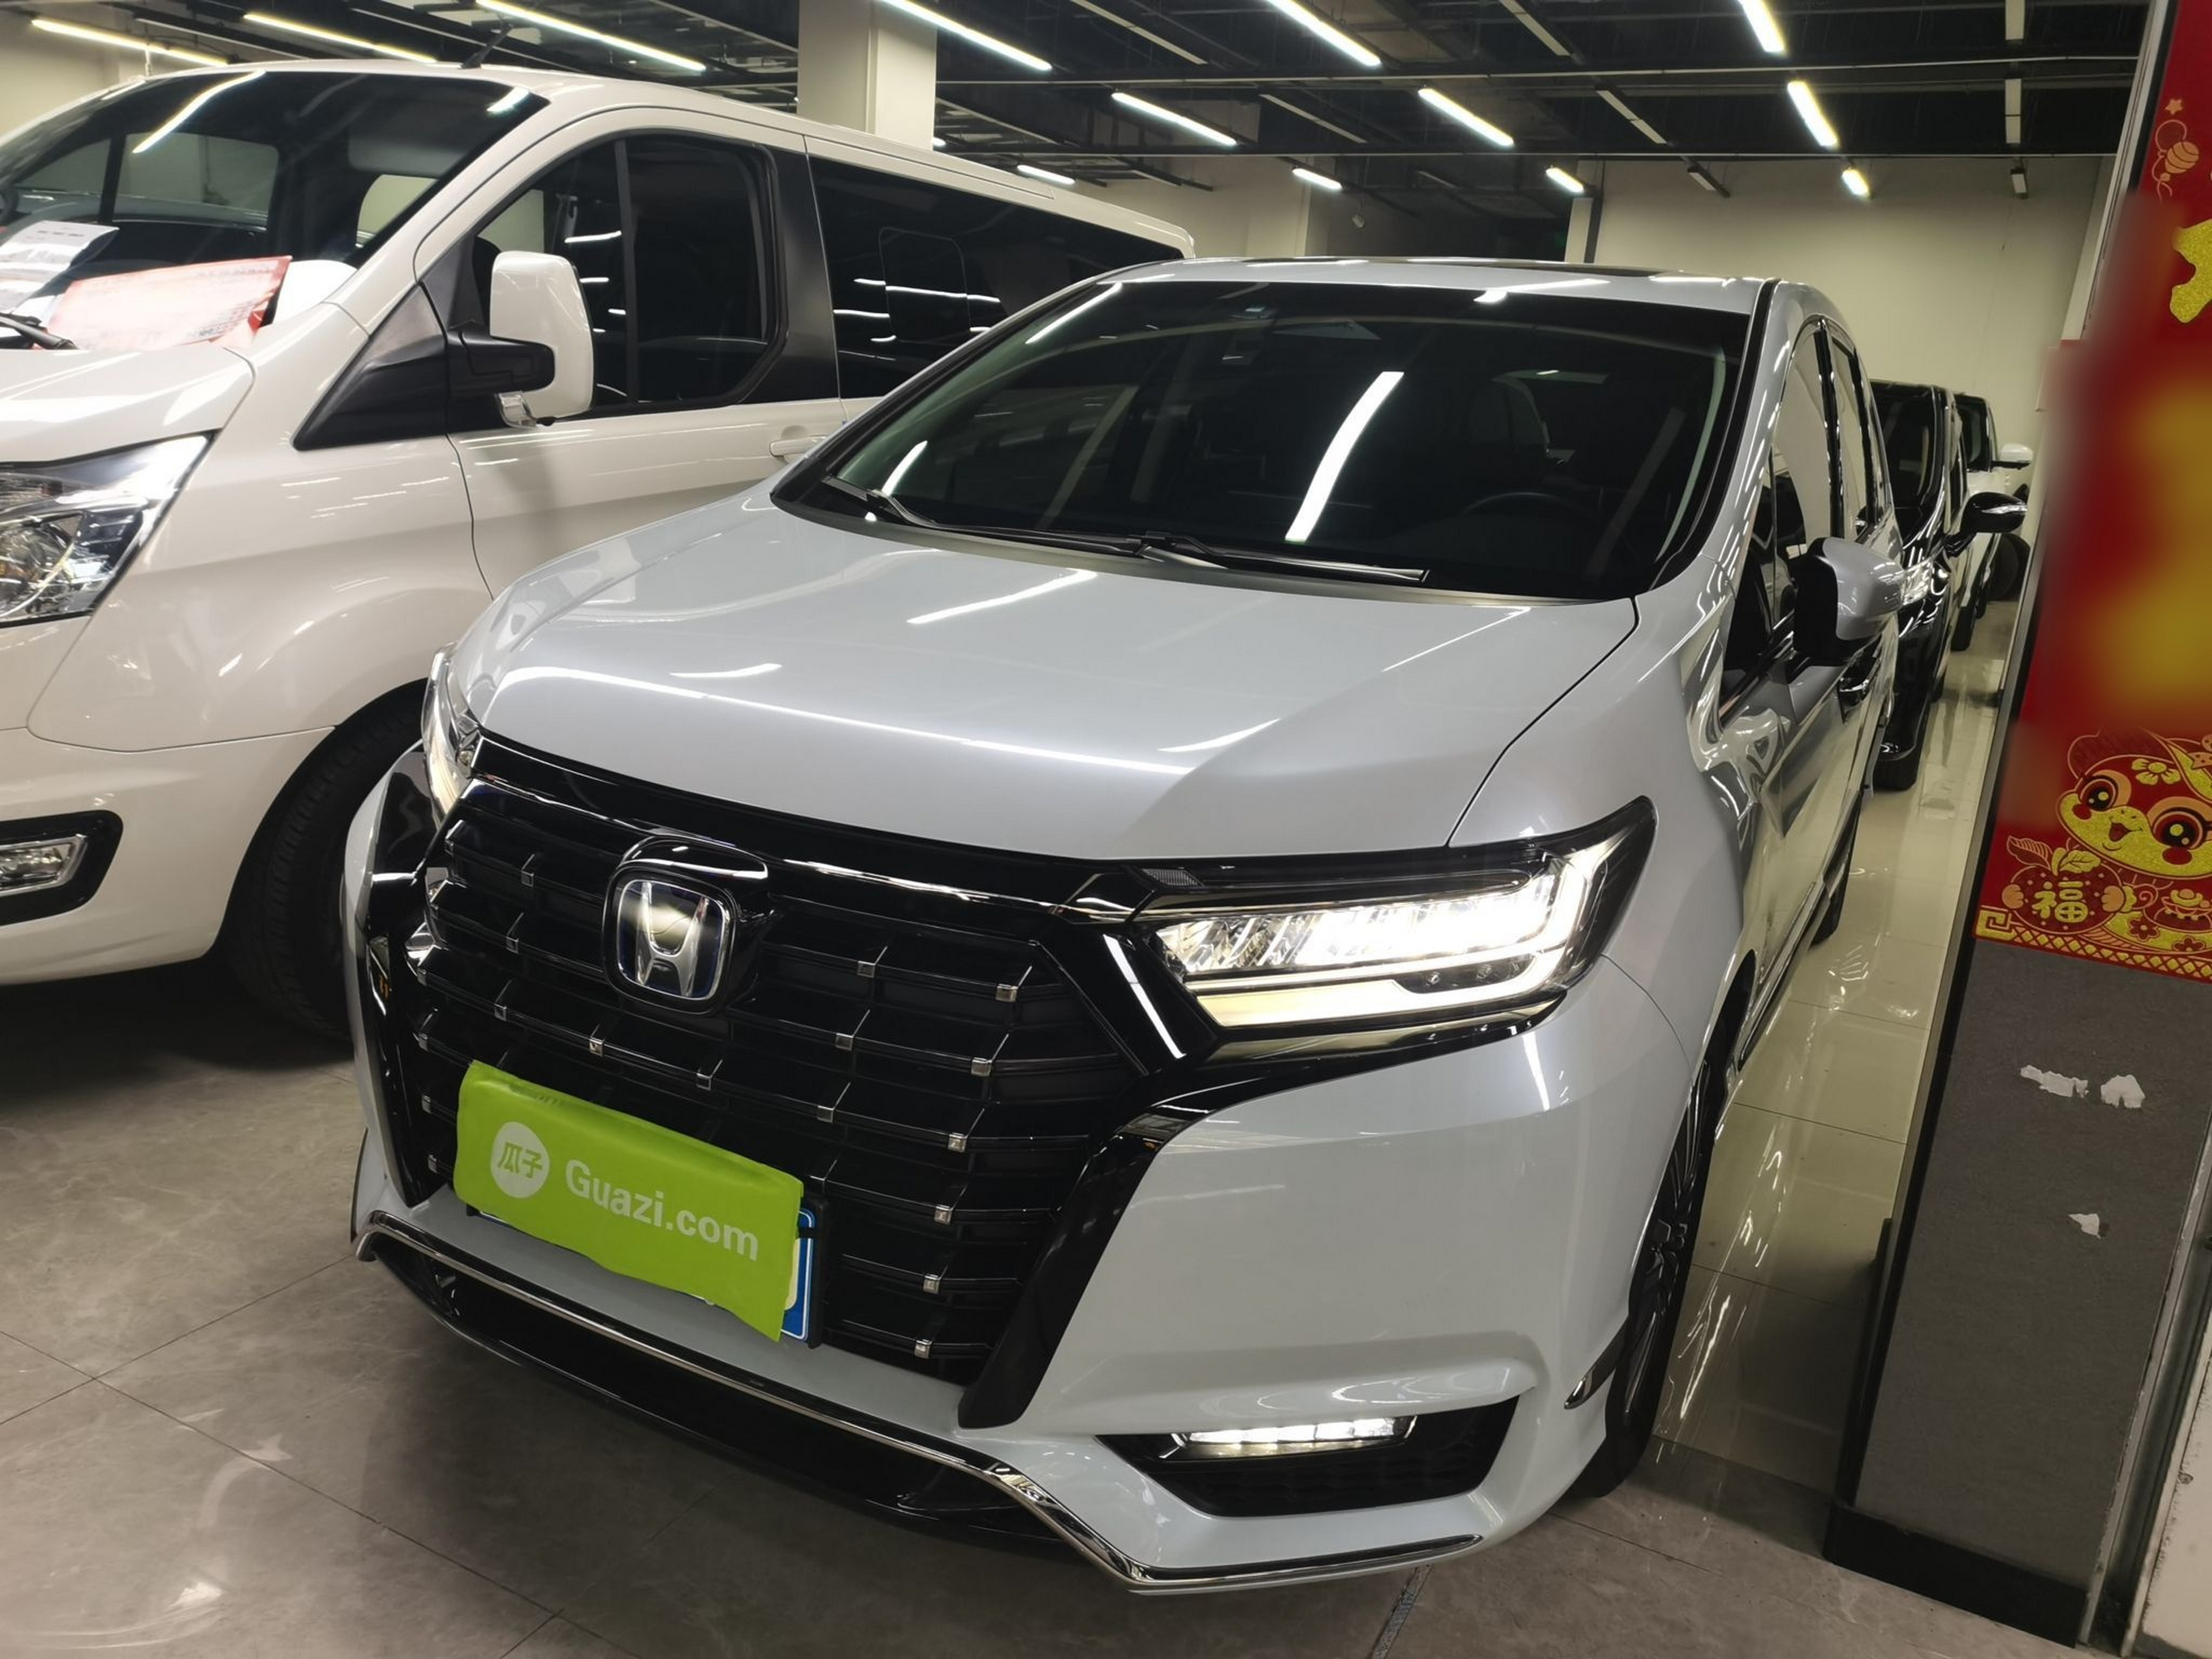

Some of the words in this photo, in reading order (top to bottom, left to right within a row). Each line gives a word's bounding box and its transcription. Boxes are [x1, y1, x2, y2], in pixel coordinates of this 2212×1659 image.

[2032, 881, 2088, 923] 福
[497, 1141, 543, 1179] 瓜子
[566, 1160, 759, 1261] Guazi.com
